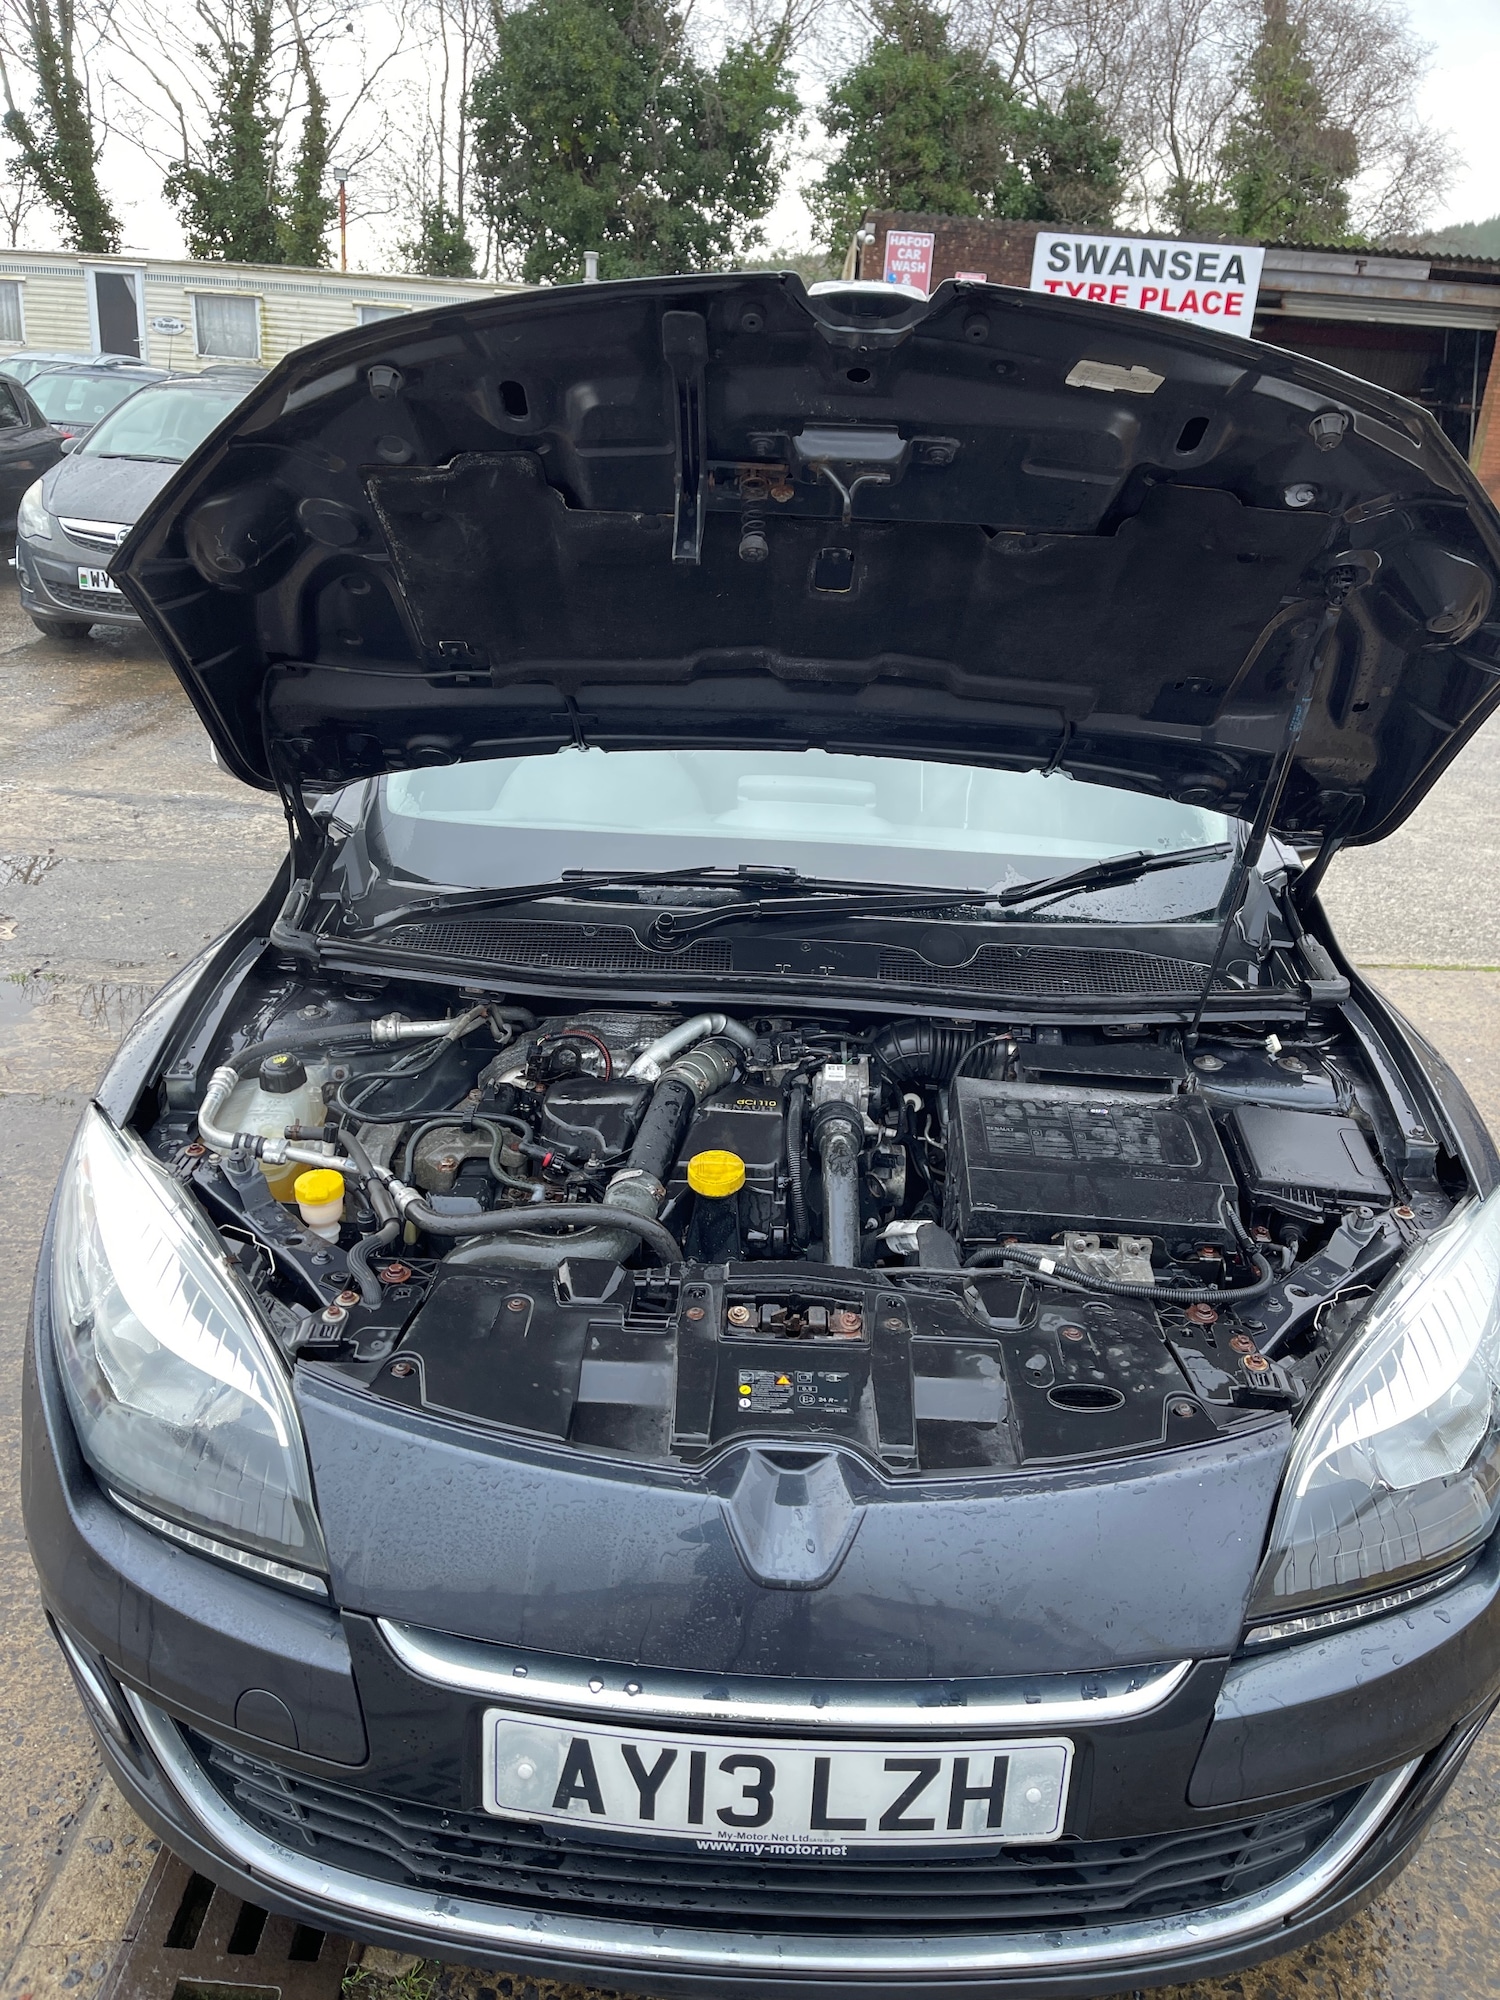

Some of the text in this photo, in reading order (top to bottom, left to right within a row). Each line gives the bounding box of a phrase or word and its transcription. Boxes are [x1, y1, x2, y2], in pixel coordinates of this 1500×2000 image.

[890, 235, 930, 247] HAFOD
[897, 248, 921, 260] CAR
[891, 260, 926, 273] WASH
[1047, 241, 1246, 285] SWANSEA
[902, 273, 912, 285] &
[1044, 279, 1245, 316] TYRE PLACE
[714, 1102, 776, 1112] RENAULT
[759, 1099, 777, 1107] 110
[552, 1737, 1010, 1831] AY13 LZH
[717, 1831, 789, 1842] My-Motor.Net
[792, 1832, 810, 1842] Ltd
[696, 1840, 848, 1856] www.my-motor.net
